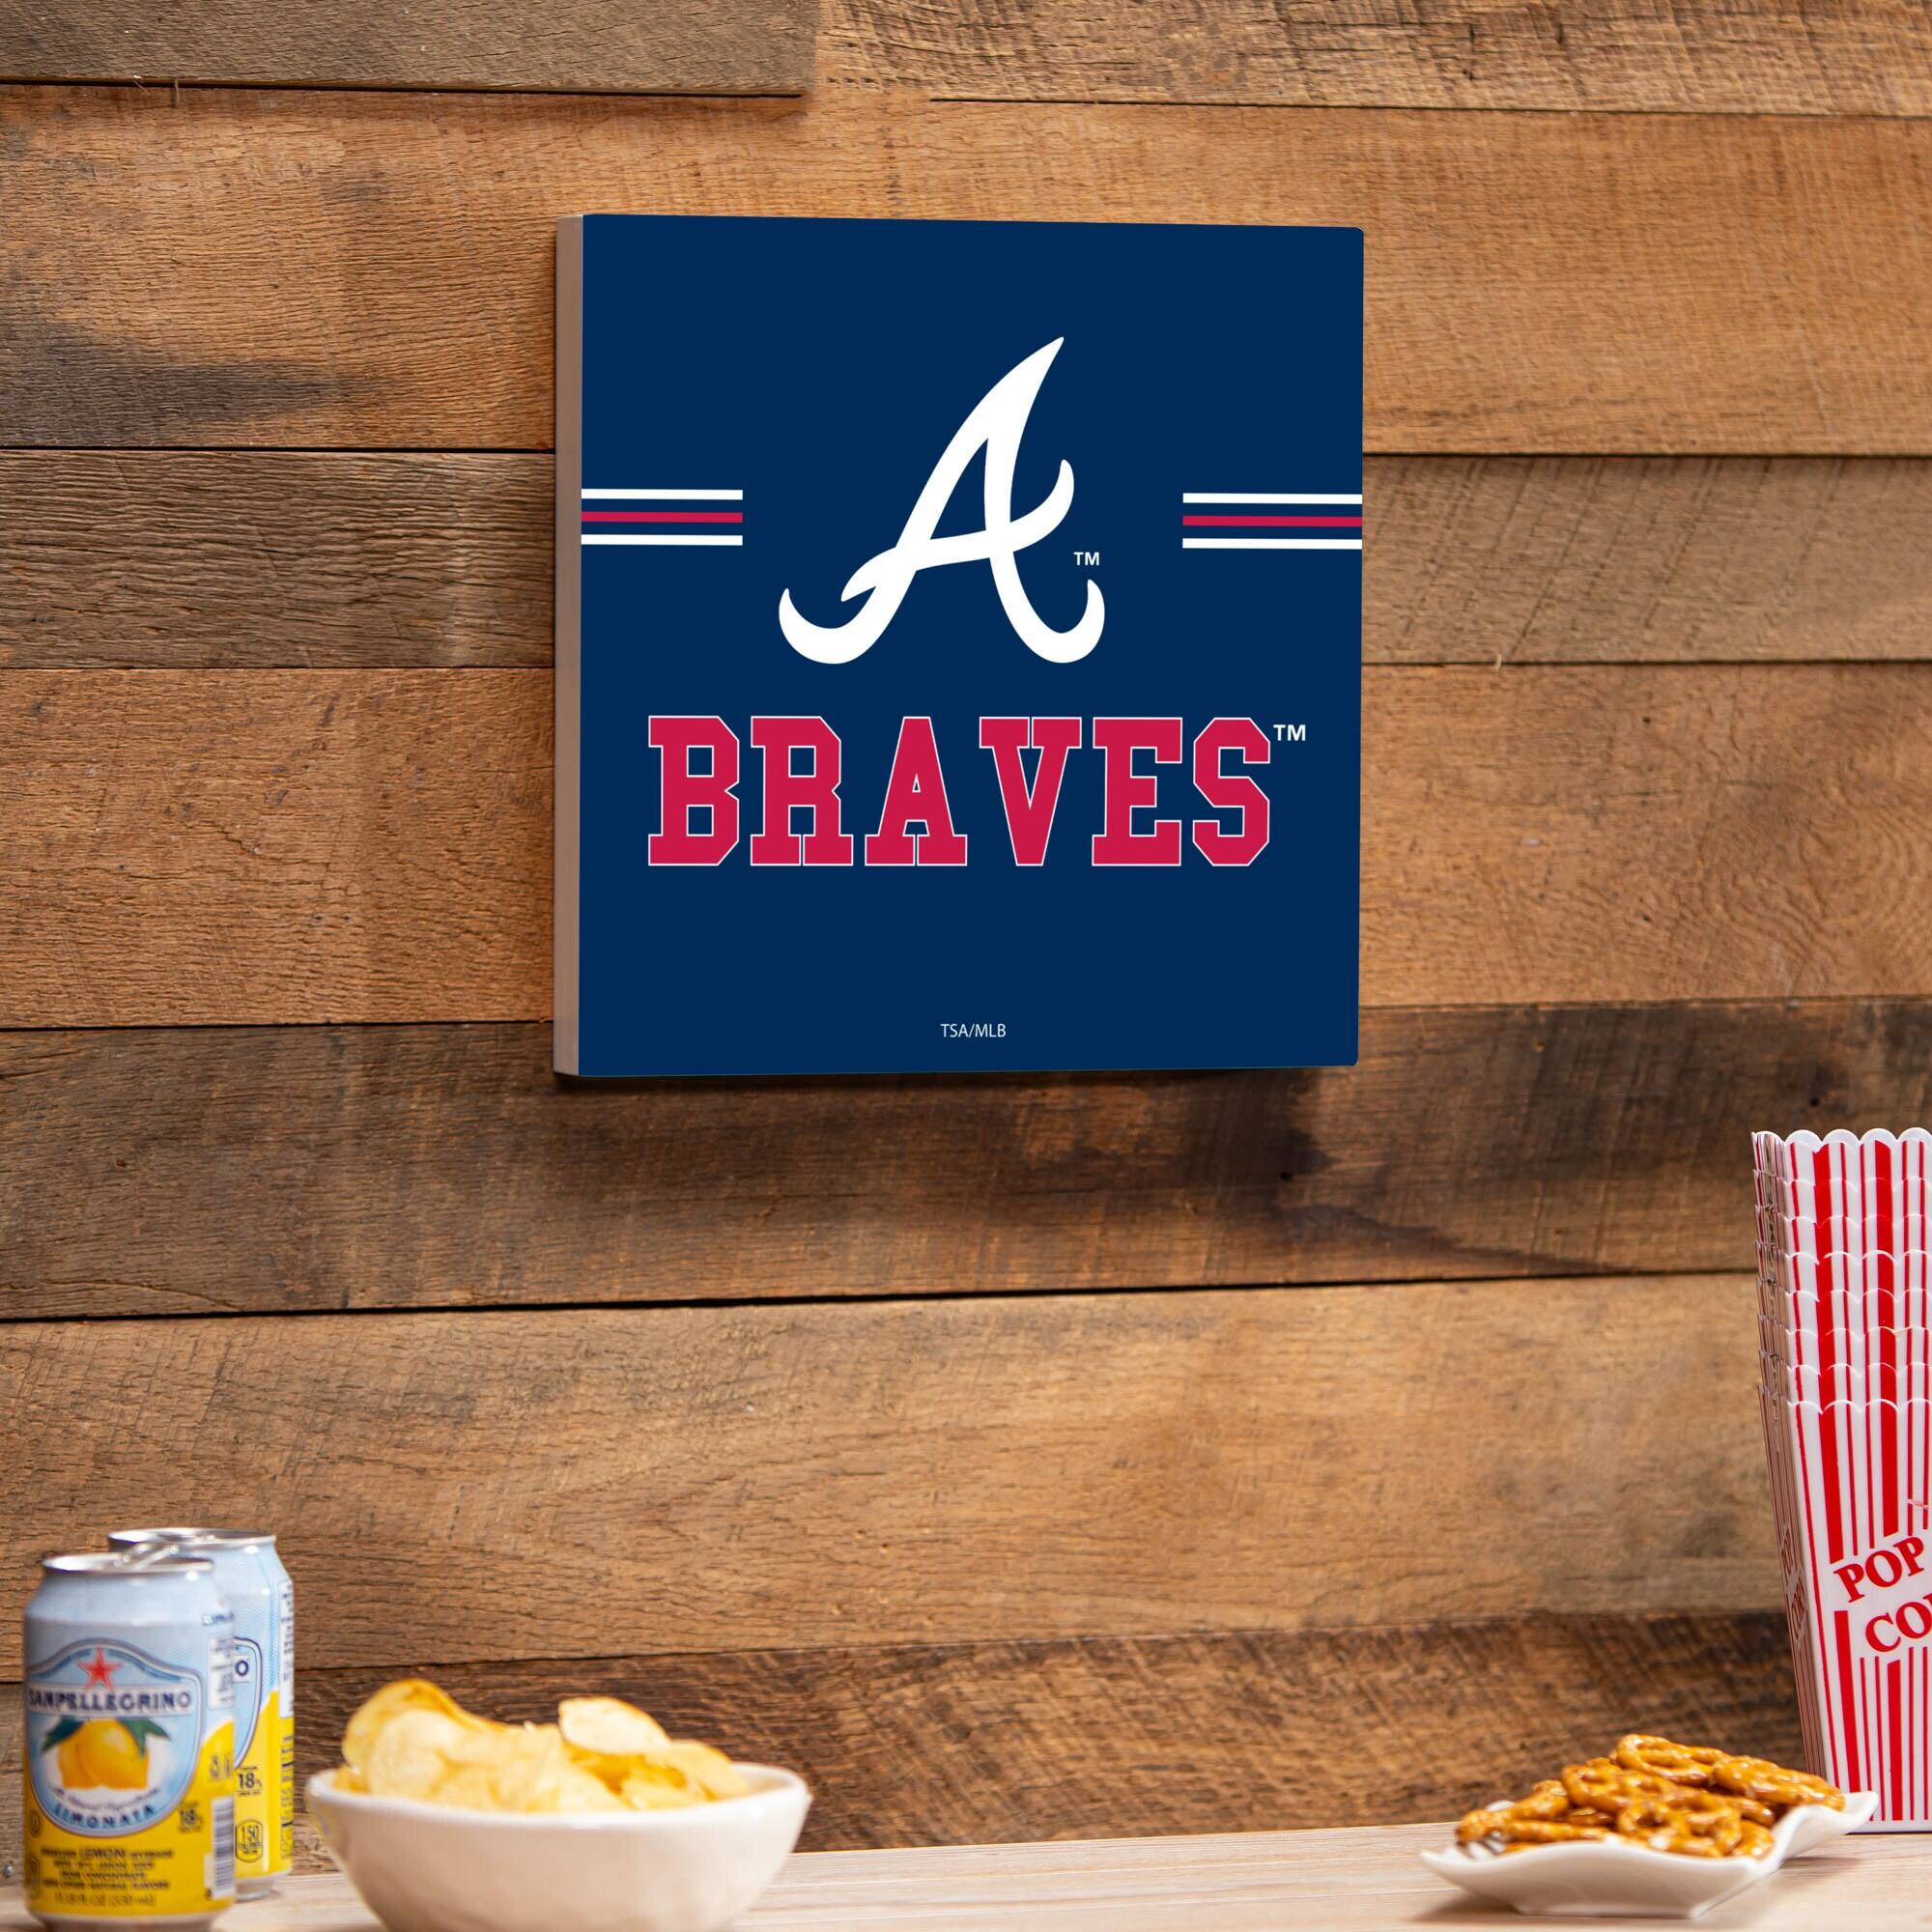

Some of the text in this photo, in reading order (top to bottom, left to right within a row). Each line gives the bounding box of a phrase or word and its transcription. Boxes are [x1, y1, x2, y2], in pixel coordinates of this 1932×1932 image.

[779, 337, 1105, 664] A
[1073, 552, 1100, 566] TM
[647, 715, 1306, 867] BRAVES TM
[940, 1023, 1007, 1038] TSA/MLB
[1833, 1537, 1925, 1604] POP
[28, 1688, 191, 1711] SANPELLEGRINO
[54, 1804, 156, 1829] LIMONATA
